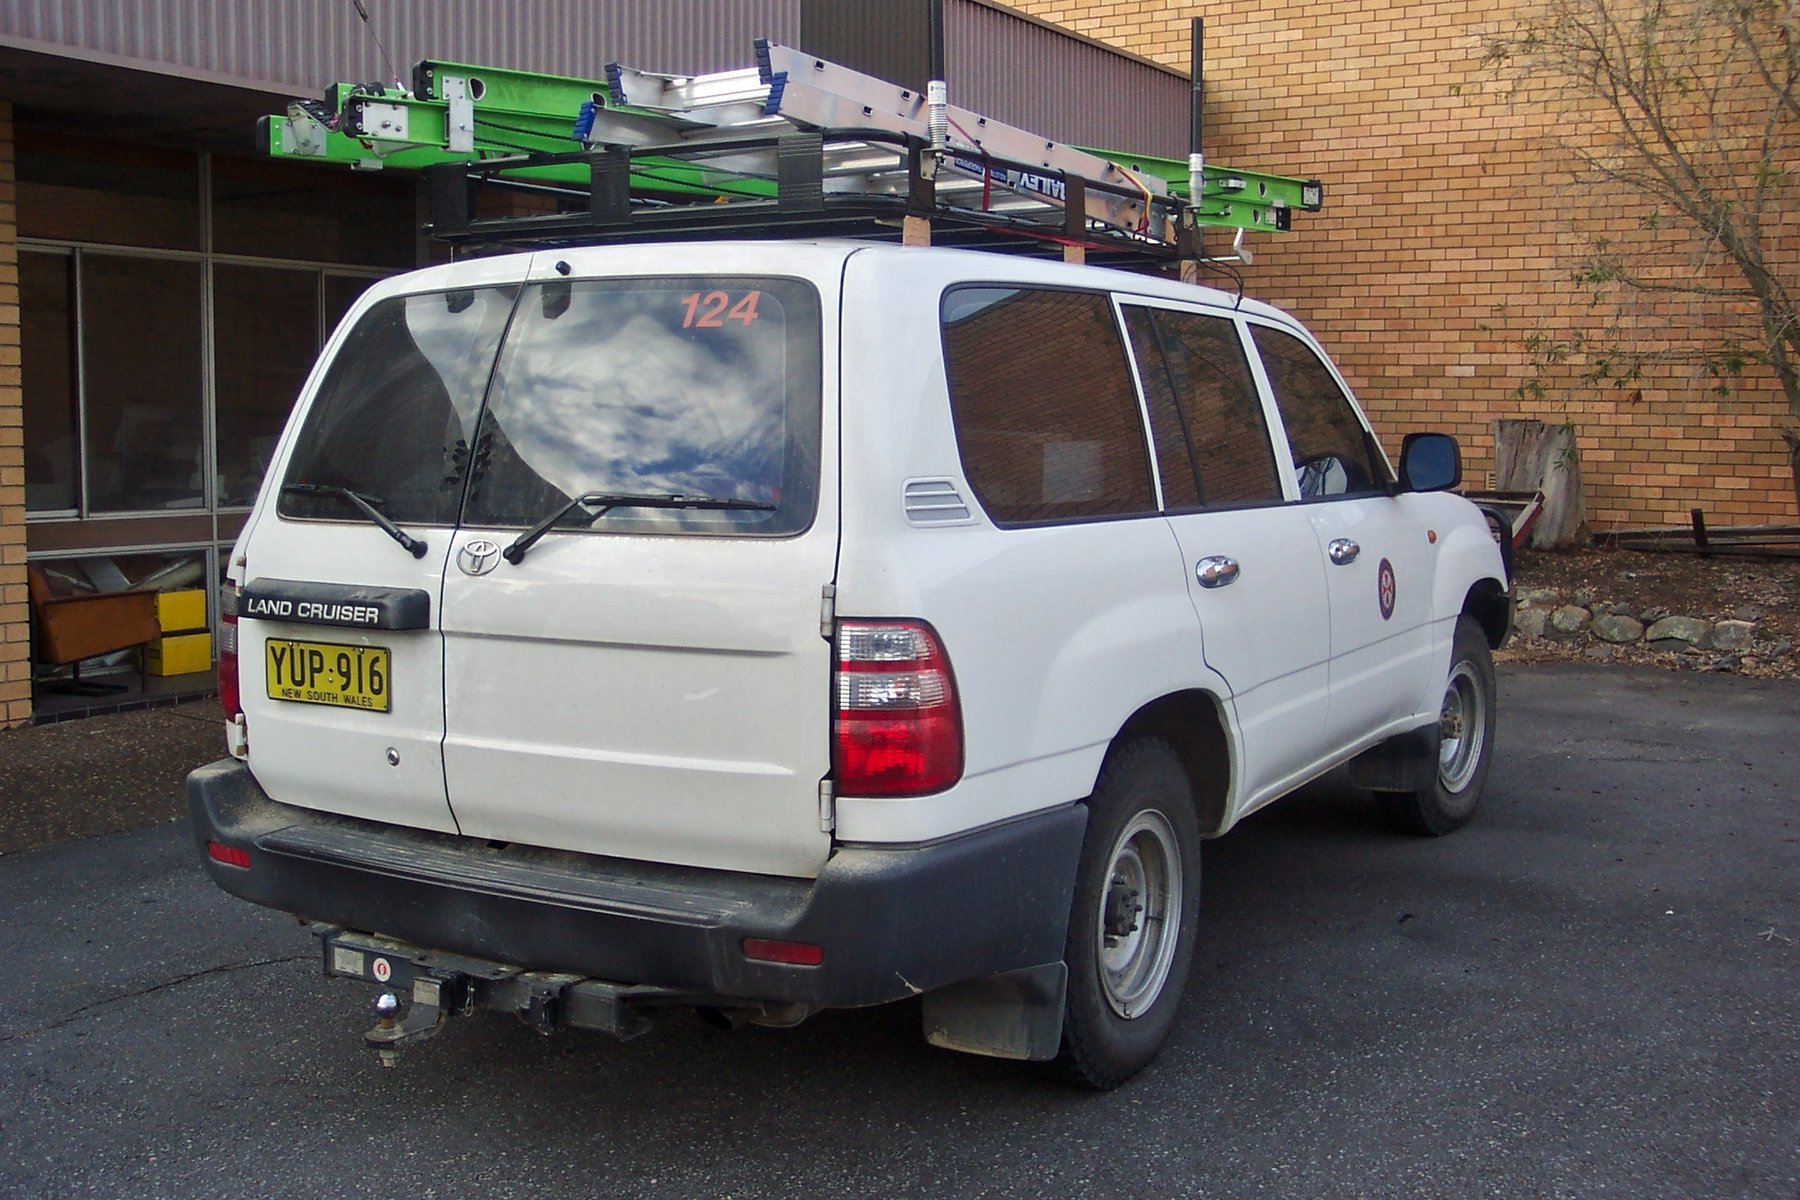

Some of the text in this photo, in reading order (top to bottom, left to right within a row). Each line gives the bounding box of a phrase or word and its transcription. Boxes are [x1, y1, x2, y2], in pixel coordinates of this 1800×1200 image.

[681, 290, 761, 329] 124
[247, 598, 379, 624] LAND CRUISER
[281, 688, 373, 708] NEW SOUTH WALES
